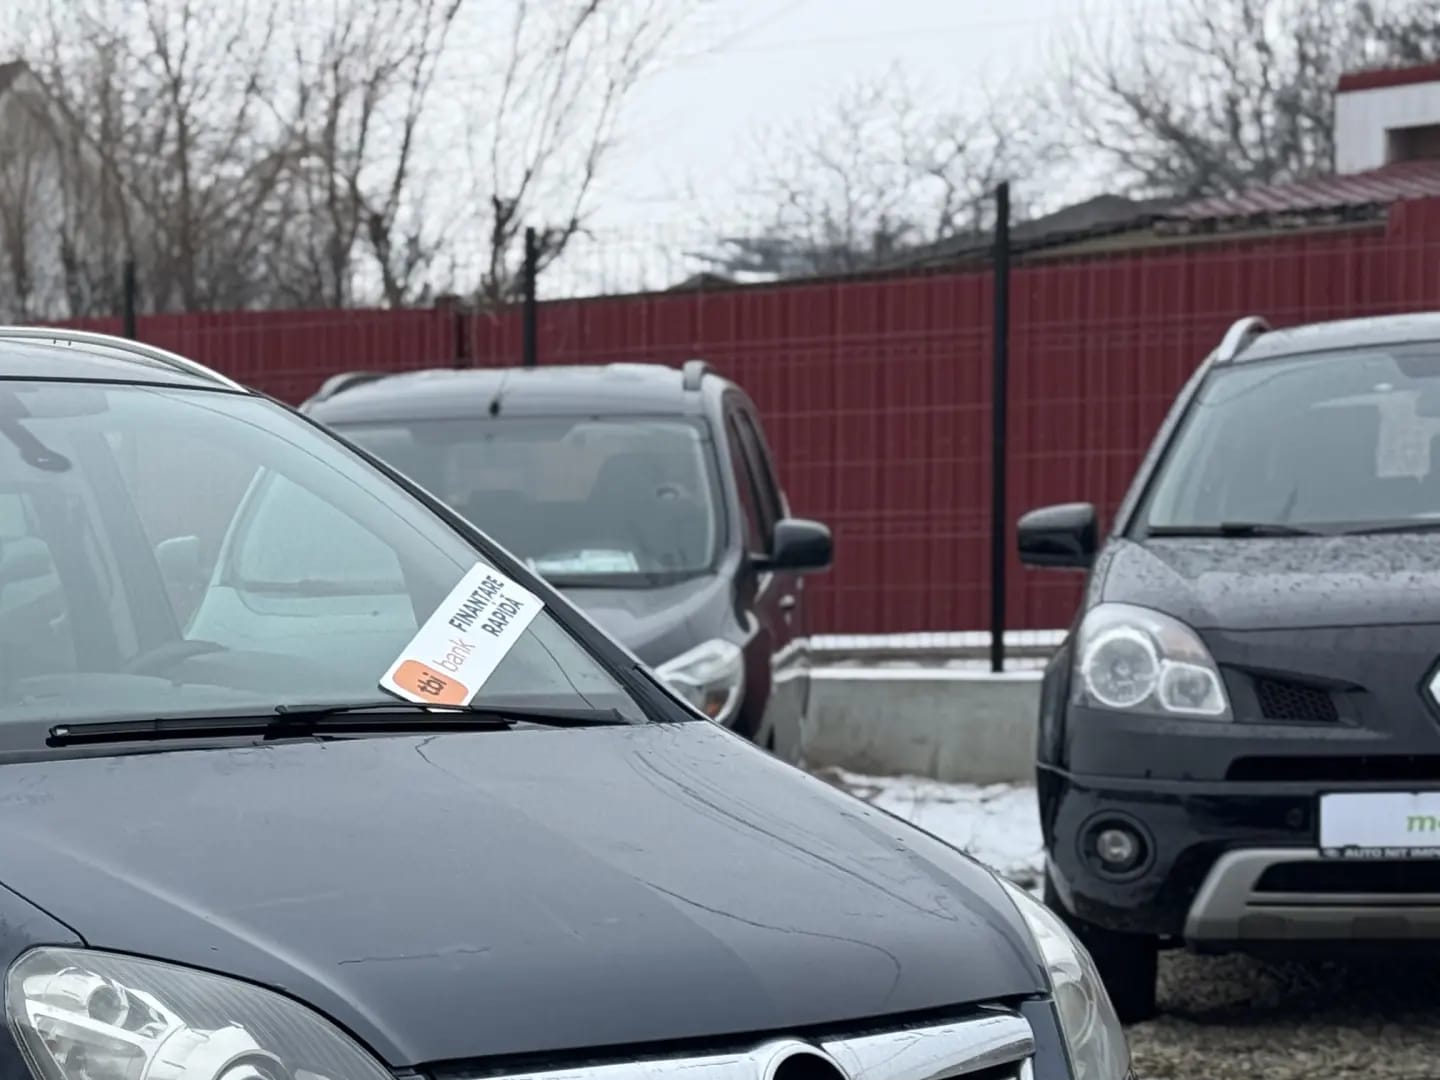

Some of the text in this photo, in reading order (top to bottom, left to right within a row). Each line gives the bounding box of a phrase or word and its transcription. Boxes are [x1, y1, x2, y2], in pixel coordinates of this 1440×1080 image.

[417, 638, 476, 695] tbi bank
[1406, 815, 1440, 832] m
[1344, 848, 1382, 858] AUTO
